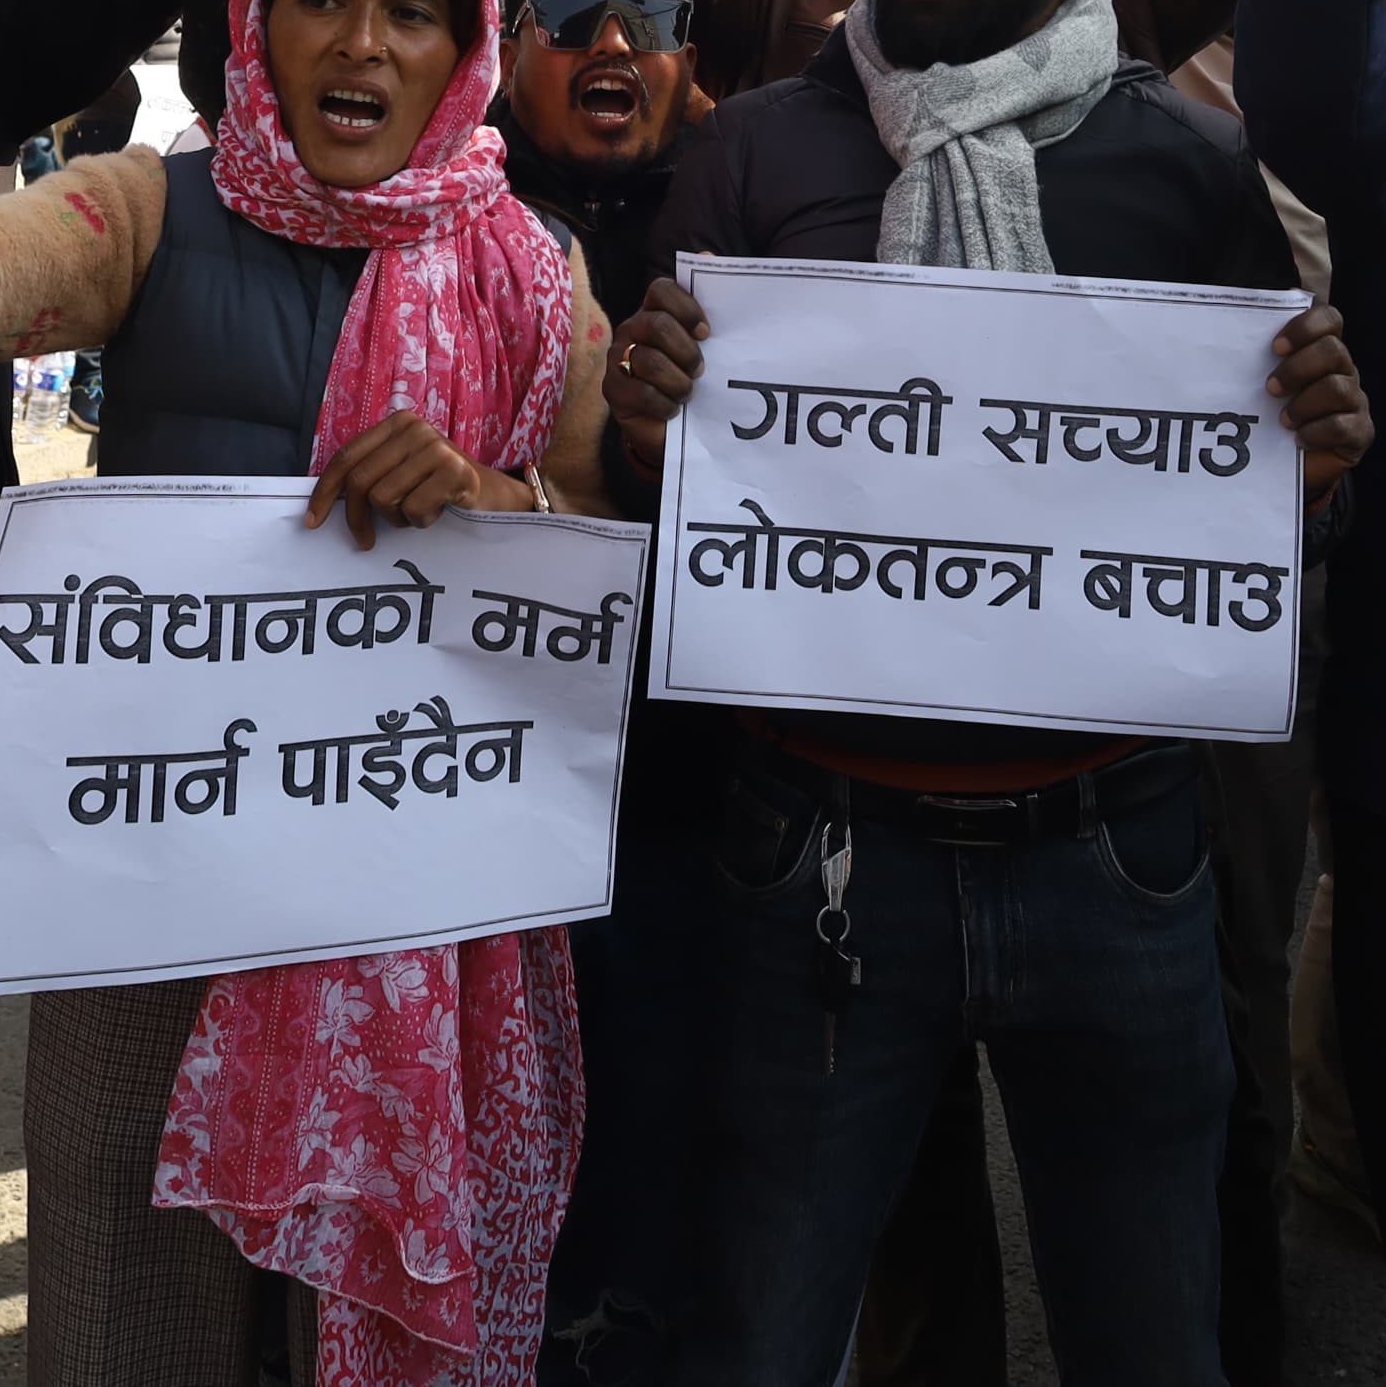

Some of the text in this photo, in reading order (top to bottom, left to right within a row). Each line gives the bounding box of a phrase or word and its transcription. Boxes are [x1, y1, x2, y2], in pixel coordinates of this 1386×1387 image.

[728, 378, 1259, 477] गल्ती सच्याउ
[687, 499, 1289, 632] लोकतन्त्र बचाउ
[472, 590, 635, 666] मर्म
[66, 695, 534, 825] मार्न पाइँदैन
